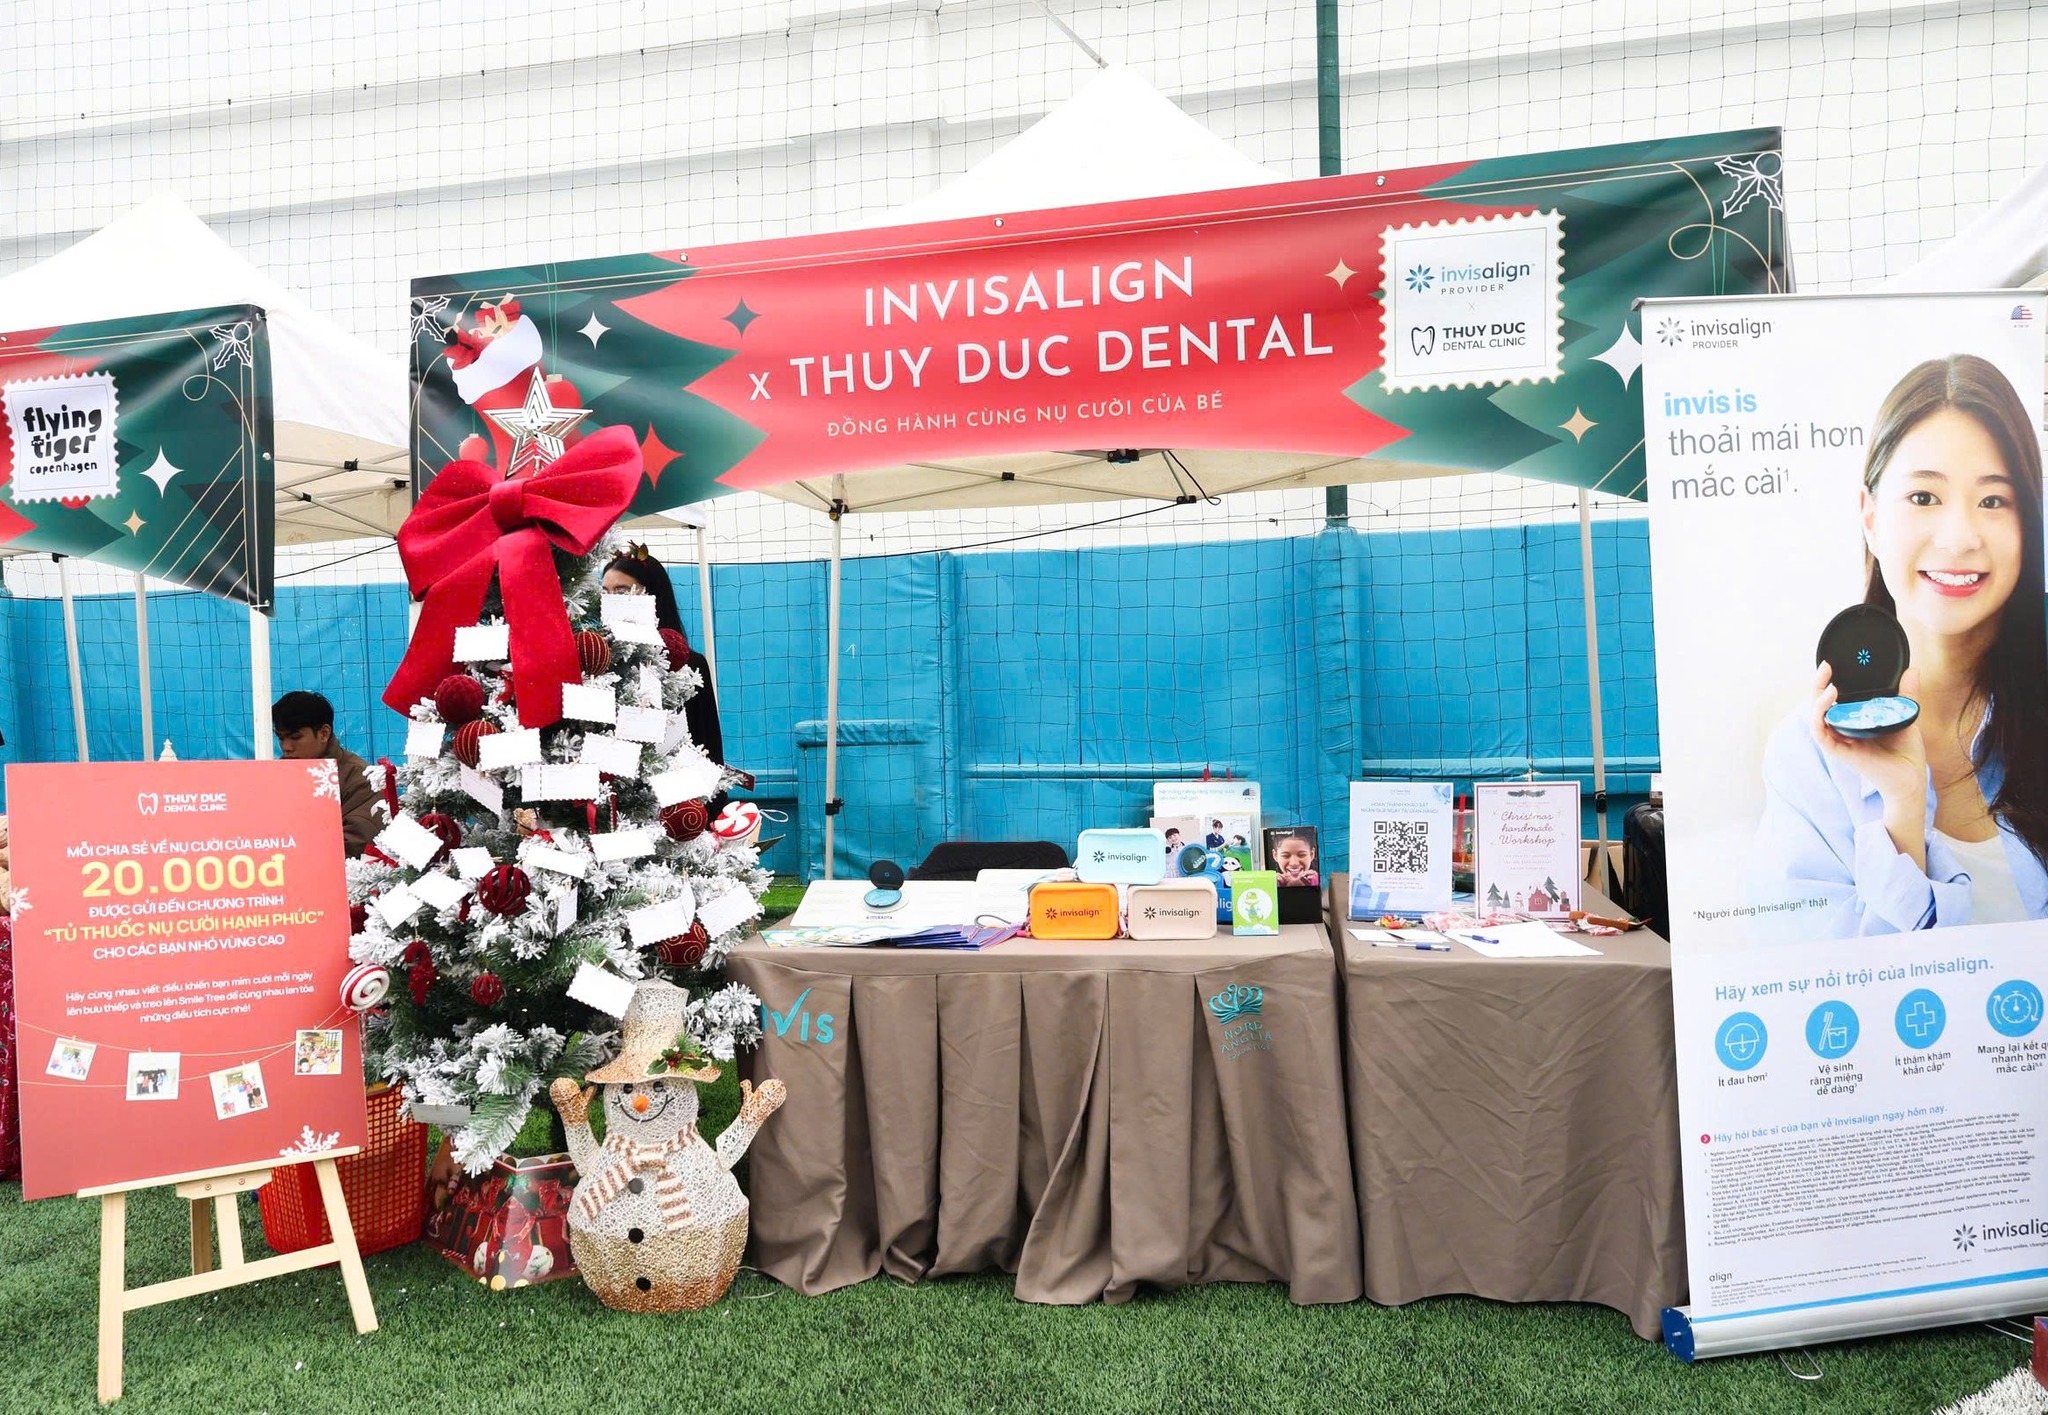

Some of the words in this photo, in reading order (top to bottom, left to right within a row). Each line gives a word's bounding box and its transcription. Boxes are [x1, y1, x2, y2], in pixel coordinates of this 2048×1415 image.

[1440, 262, 1531, 283] invisalign
[866, 255, 1193, 326] INVISALIGN
[1440, 283, 1505, 295] PROVIDER
[1442, 324, 1487, 340] THUY
[1490, 321, 1526, 336] DUC
[1690, 317, 1773, 339] invisalign
[1442, 339, 1486, 351] DENTAL
[1488, 336, 1526, 348] CLINIC
[1692, 339, 1739, 349] PROVIDER
[748, 372, 771, 401] x
[789, 346, 932, 397] THUY
[957, 335, 1071, 384] DUC
[1098, 312, 1334, 373] DENTAL
[1664, 389, 1731, 417] invis
[1734, 387, 1758, 414] is
[22, 404, 103, 437] flying
[827, 415, 888, 437] ĐỒNG
[897, 412, 957, 432] HÀNH
[966, 407, 1027, 427] CÙNG
[1037, 404, 1068, 424] NỤ
[1077, 398, 1131, 419] CƯỜI
[1142, 393, 1187, 414] CỦA
[1196, 389, 1224, 410] BÉ
[31, 432, 96, 463] tiger
[1668, 424, 1741, 456] thoải
[1751, 423, 1800, 452] mái
[1810, 421, 1864, 449] hơn
[29, 461, 98, 476] copenhagen
[1671, 463, 1736, 500] mắc
[163, 793, 197, 803] THUY
[200, 793, 227, 803] DUC
[164, 804, 197, 813] DENTAL
[200, 803, 227, 812] CLINIC
[1500, 810, 1554, 821] Christmas
[1501, 822, 1554, 832] handmade
[66, 841, 94, 858] MỖI
[96, 844, 130, 857] CHIA
[132, 840, 149, 855] SẺ
[150, 838, 168, 854] VỀ
[169, 842, 189, 855] NỤ
[190, 837, 223, 852] CƯỜI
[225, 836, 252, 851] CỦA
[253, 838, 280, 851] BẠN
[281, 835, 297, 848] LÀ
[1498, 834, 1556, 847] Workshop
[1107, 852, 1147, 863] invisalign
[81, 853, 286, 897] 20.000đ
[89, 904, 131, 918] ĐƯỢC
[132, 899, 157, 915] GỬI
[158, 898, 185, 913] ĐẾN
[187, 897, 246, 912] CHƯƠNG
[247, 893, 285, 908] TRÌNH
[1060, 908, 1100, 918] invisalign
[1159, 909, 1200, 919] invisalign
[1732, 906, 1756, 917] dùng
[1808, 897, 1828, 909] thật
[80, 917, 145, 940] THUỐC
[148, 921, 173, 938] NỤ
[176, 914, 220, 934] CƯỜI
[222, 914, 270, 932] HẠNH
[93, 946, 125, 960] CHO
[127, 942, 157, 957] CÁC
[159, 942, 187, 958] BẠN
[188, 937, 218, 952] NHỎ
[219, 935, 257, 950] VÙNG
[258, 934, 285, 947] CAO
[66, 991, 86, 1002] Hãy
[87, 989, 113, 1000] cùng
[115, 987, 140, 998] nhau
[142, 984, 161, 995] viết
[185, 980, 210, 991] khiến
[212, 978, 230, 988] bạn
[253, 973, 272, 985] cười
[274, 971, 290, 982] mỗi
[292, 971, 313, 983] ngày
[1715, 984, 1747, 1002] Hãy
[1751, 981, 1784, 997] xem
[1788, 978, 1811, 994] sự
[1815, 969, 1841, 989] nổi
[1846, 968, 1873, 987] trội
[1878, 965, 1906, 982] của
[1910, 956, 1994, 977] Invisalign.
[66, 1005, 82, 1016] lên
[104, 1001, 129, 1013] thiếp
[130, 1000, 142, 1009] và
[142, 999, 162, 1009] treo
[163, 997, 178, 1007] lên
[178, 993, 204, 1005] Smile
[205, 992, 226, 1003] Tree
[240, 988, 262, 999] cùng
[262, 985, 284, 996] nhau
[285, 984, 298, 995] lan
[140, 1009, 171, 1022] những
[194, 1006, 212, 1017] tích
[213, 1005, 231, 1017] cực
[231, 1003, 251, 1014] nhé!
[1224, 1021, 1263, 1040] NORD
[1221, 1031, 1272, 1053] ANGLIA
[1977, 1044, 2006, 1055] Mang
[2008, 1043, 2021, 1053] lại
[2023, 1040, 2039, 1051] kết
[1903, 1052, 1926, 1065] thăm
[1927, 1050, 1952, 1061] khám
[1991, 1053, 2024, 1064] nhanh
[2026, 1050, 2047, 1061] hơn
[1818, 1064, 1830, 1075] Vệ
[1833, 1061, 1854, 1073] sinh
[1902, 1064, 1925, 1076] khẩn
[1996, 1063, 2018, 1074] mắc
[1727, 1076, 1745, 1087] đau
[1810, 1075, 1832, 1087] răng
[1834, 1072, 1864, 1084] miệng
[1816, 1084, 1829, 1096] dễ
[1713, 1133, 1733, 1144] Hãy
[1735, 1130, 1750, 1141] hỏi
[1751, 1127, 1769, 1138] bác
[1780, 1123, 1799, 1134] của
[1800, 1120, 1819, 1133] bạn
[1821, 1117, 1833, 1129] về
[1834, 1112, 1881, 1126] Invisalign
[1882, 1109, 1906, 1122] ngay
[1907, 1106, 1928, 1118] hôm
[1709, 1271, 1733, 1283] align
